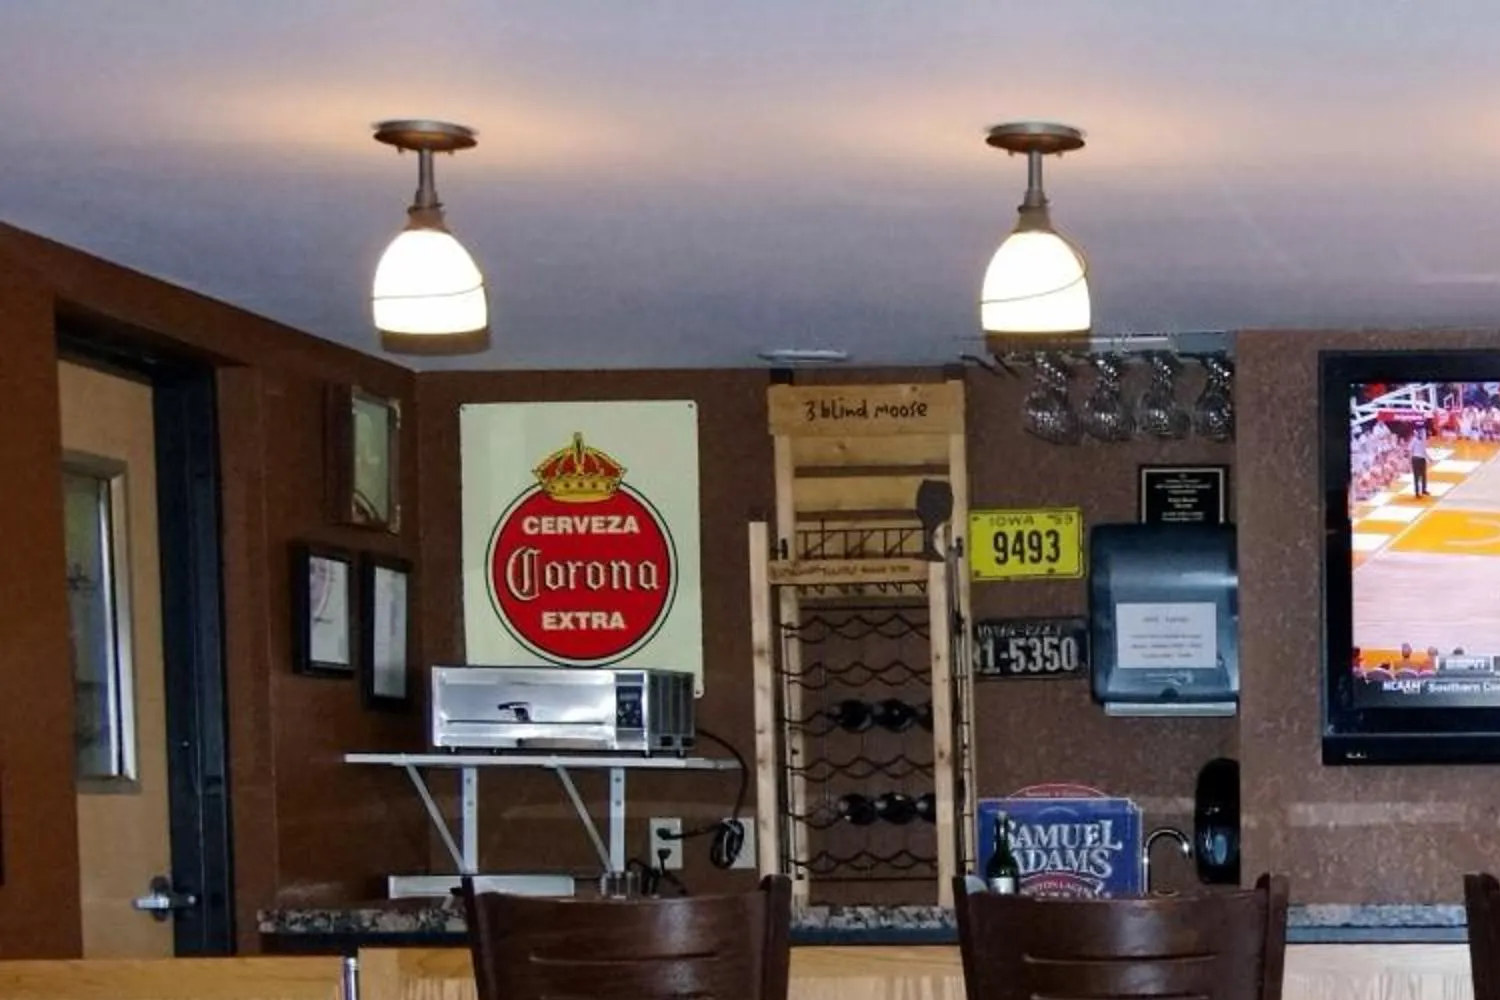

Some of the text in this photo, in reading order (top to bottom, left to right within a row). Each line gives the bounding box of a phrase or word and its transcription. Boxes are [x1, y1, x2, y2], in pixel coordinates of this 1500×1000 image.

[803, 400, 928, 421] 3 blind moose
[522, 515, 641, 535] CERVEZA
[993, 529, 1061, 565] 9493
[506, 546, 661, 601] Corona
[541, 611, 627, 631] EXTRA
